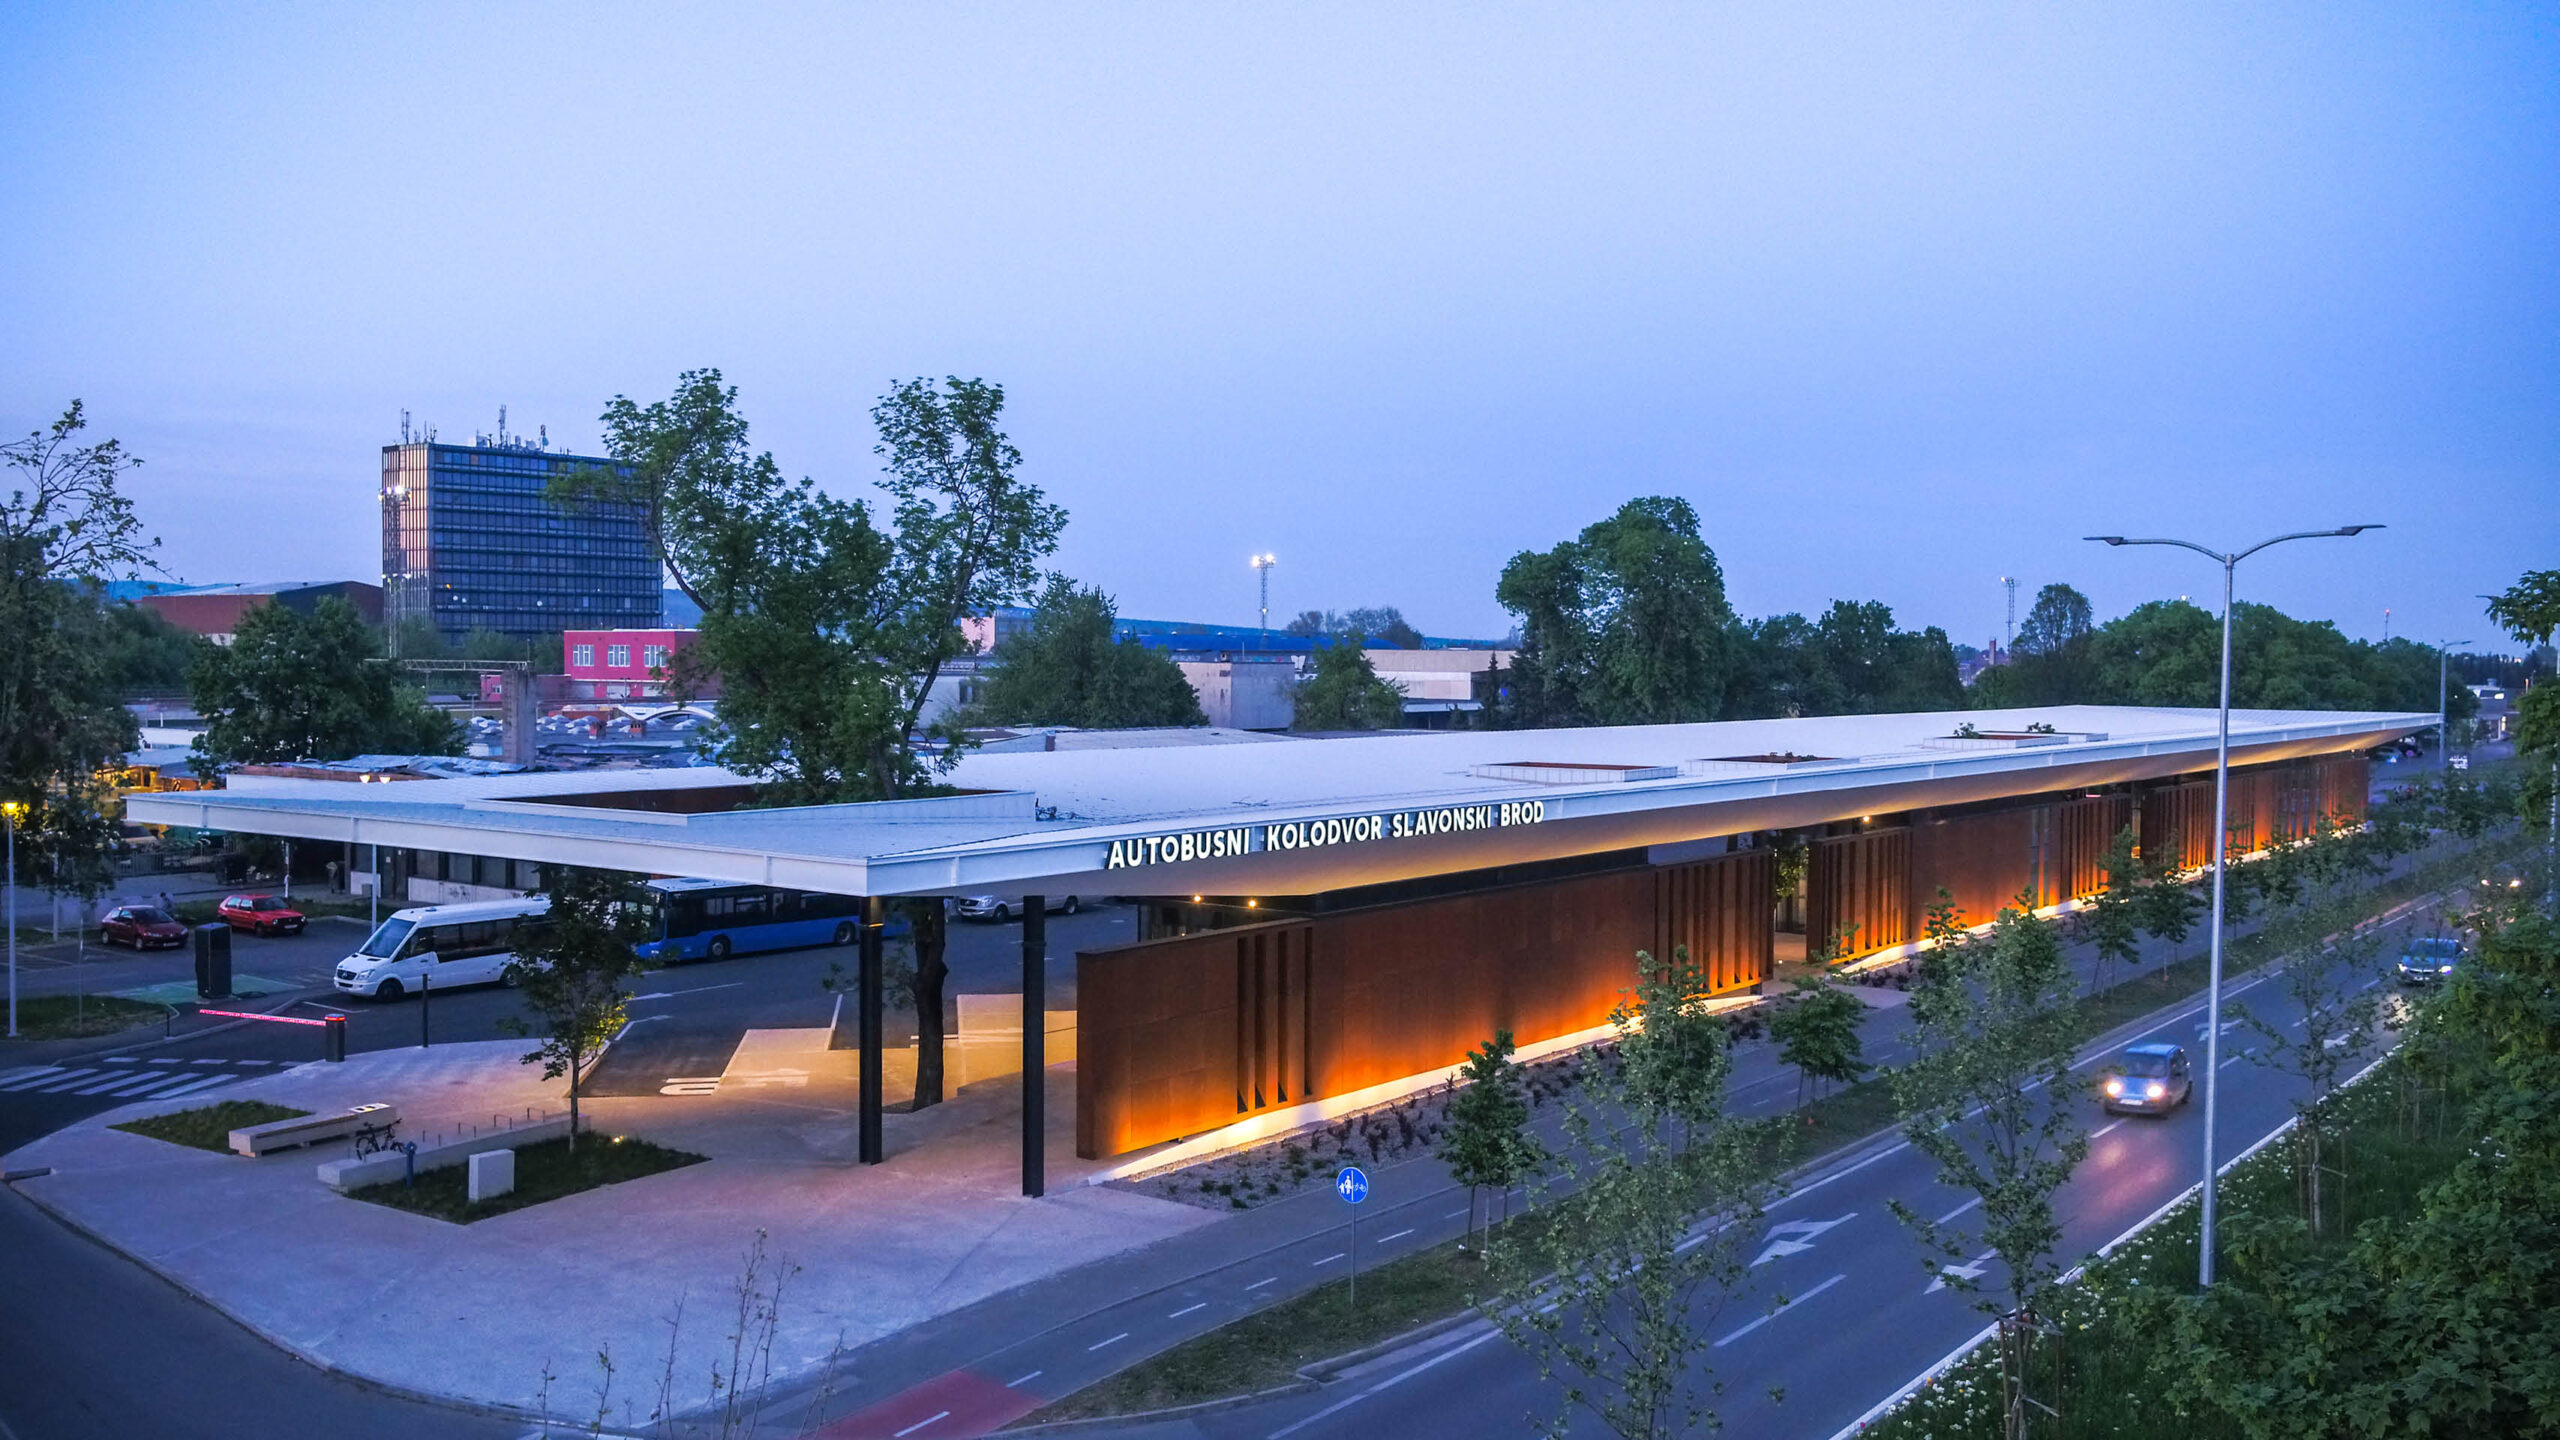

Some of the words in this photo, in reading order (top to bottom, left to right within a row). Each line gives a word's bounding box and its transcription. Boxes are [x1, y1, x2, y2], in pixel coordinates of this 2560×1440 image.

[1108, 828, 1250, 870] AUTOBUSNI
[1267, 815, 1382, 851] KOLODVOR
[1392, 806, 1491, 838] SLAVONSKI
[1501, 801, 1544, 826] BROD
